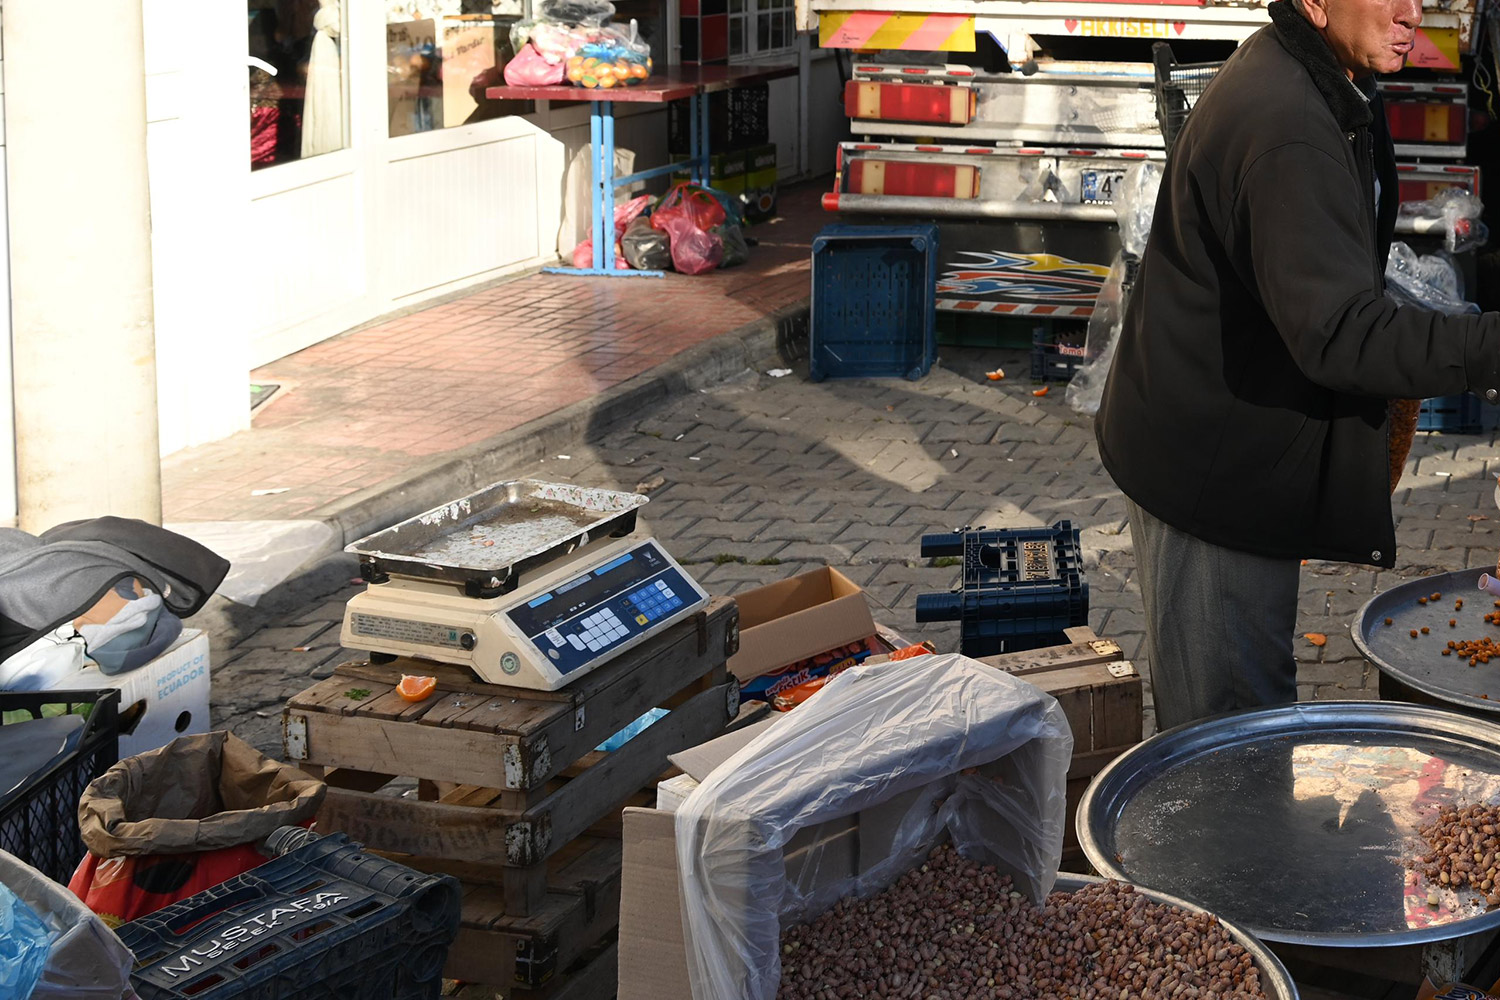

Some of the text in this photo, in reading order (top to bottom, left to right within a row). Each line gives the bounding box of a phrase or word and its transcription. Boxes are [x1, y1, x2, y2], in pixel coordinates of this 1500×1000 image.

[158, 666, 205, 700] ECUADOR
[161, 892, 343, 979] MUSTAFA
[207, 921, 285, 959] SELEK
